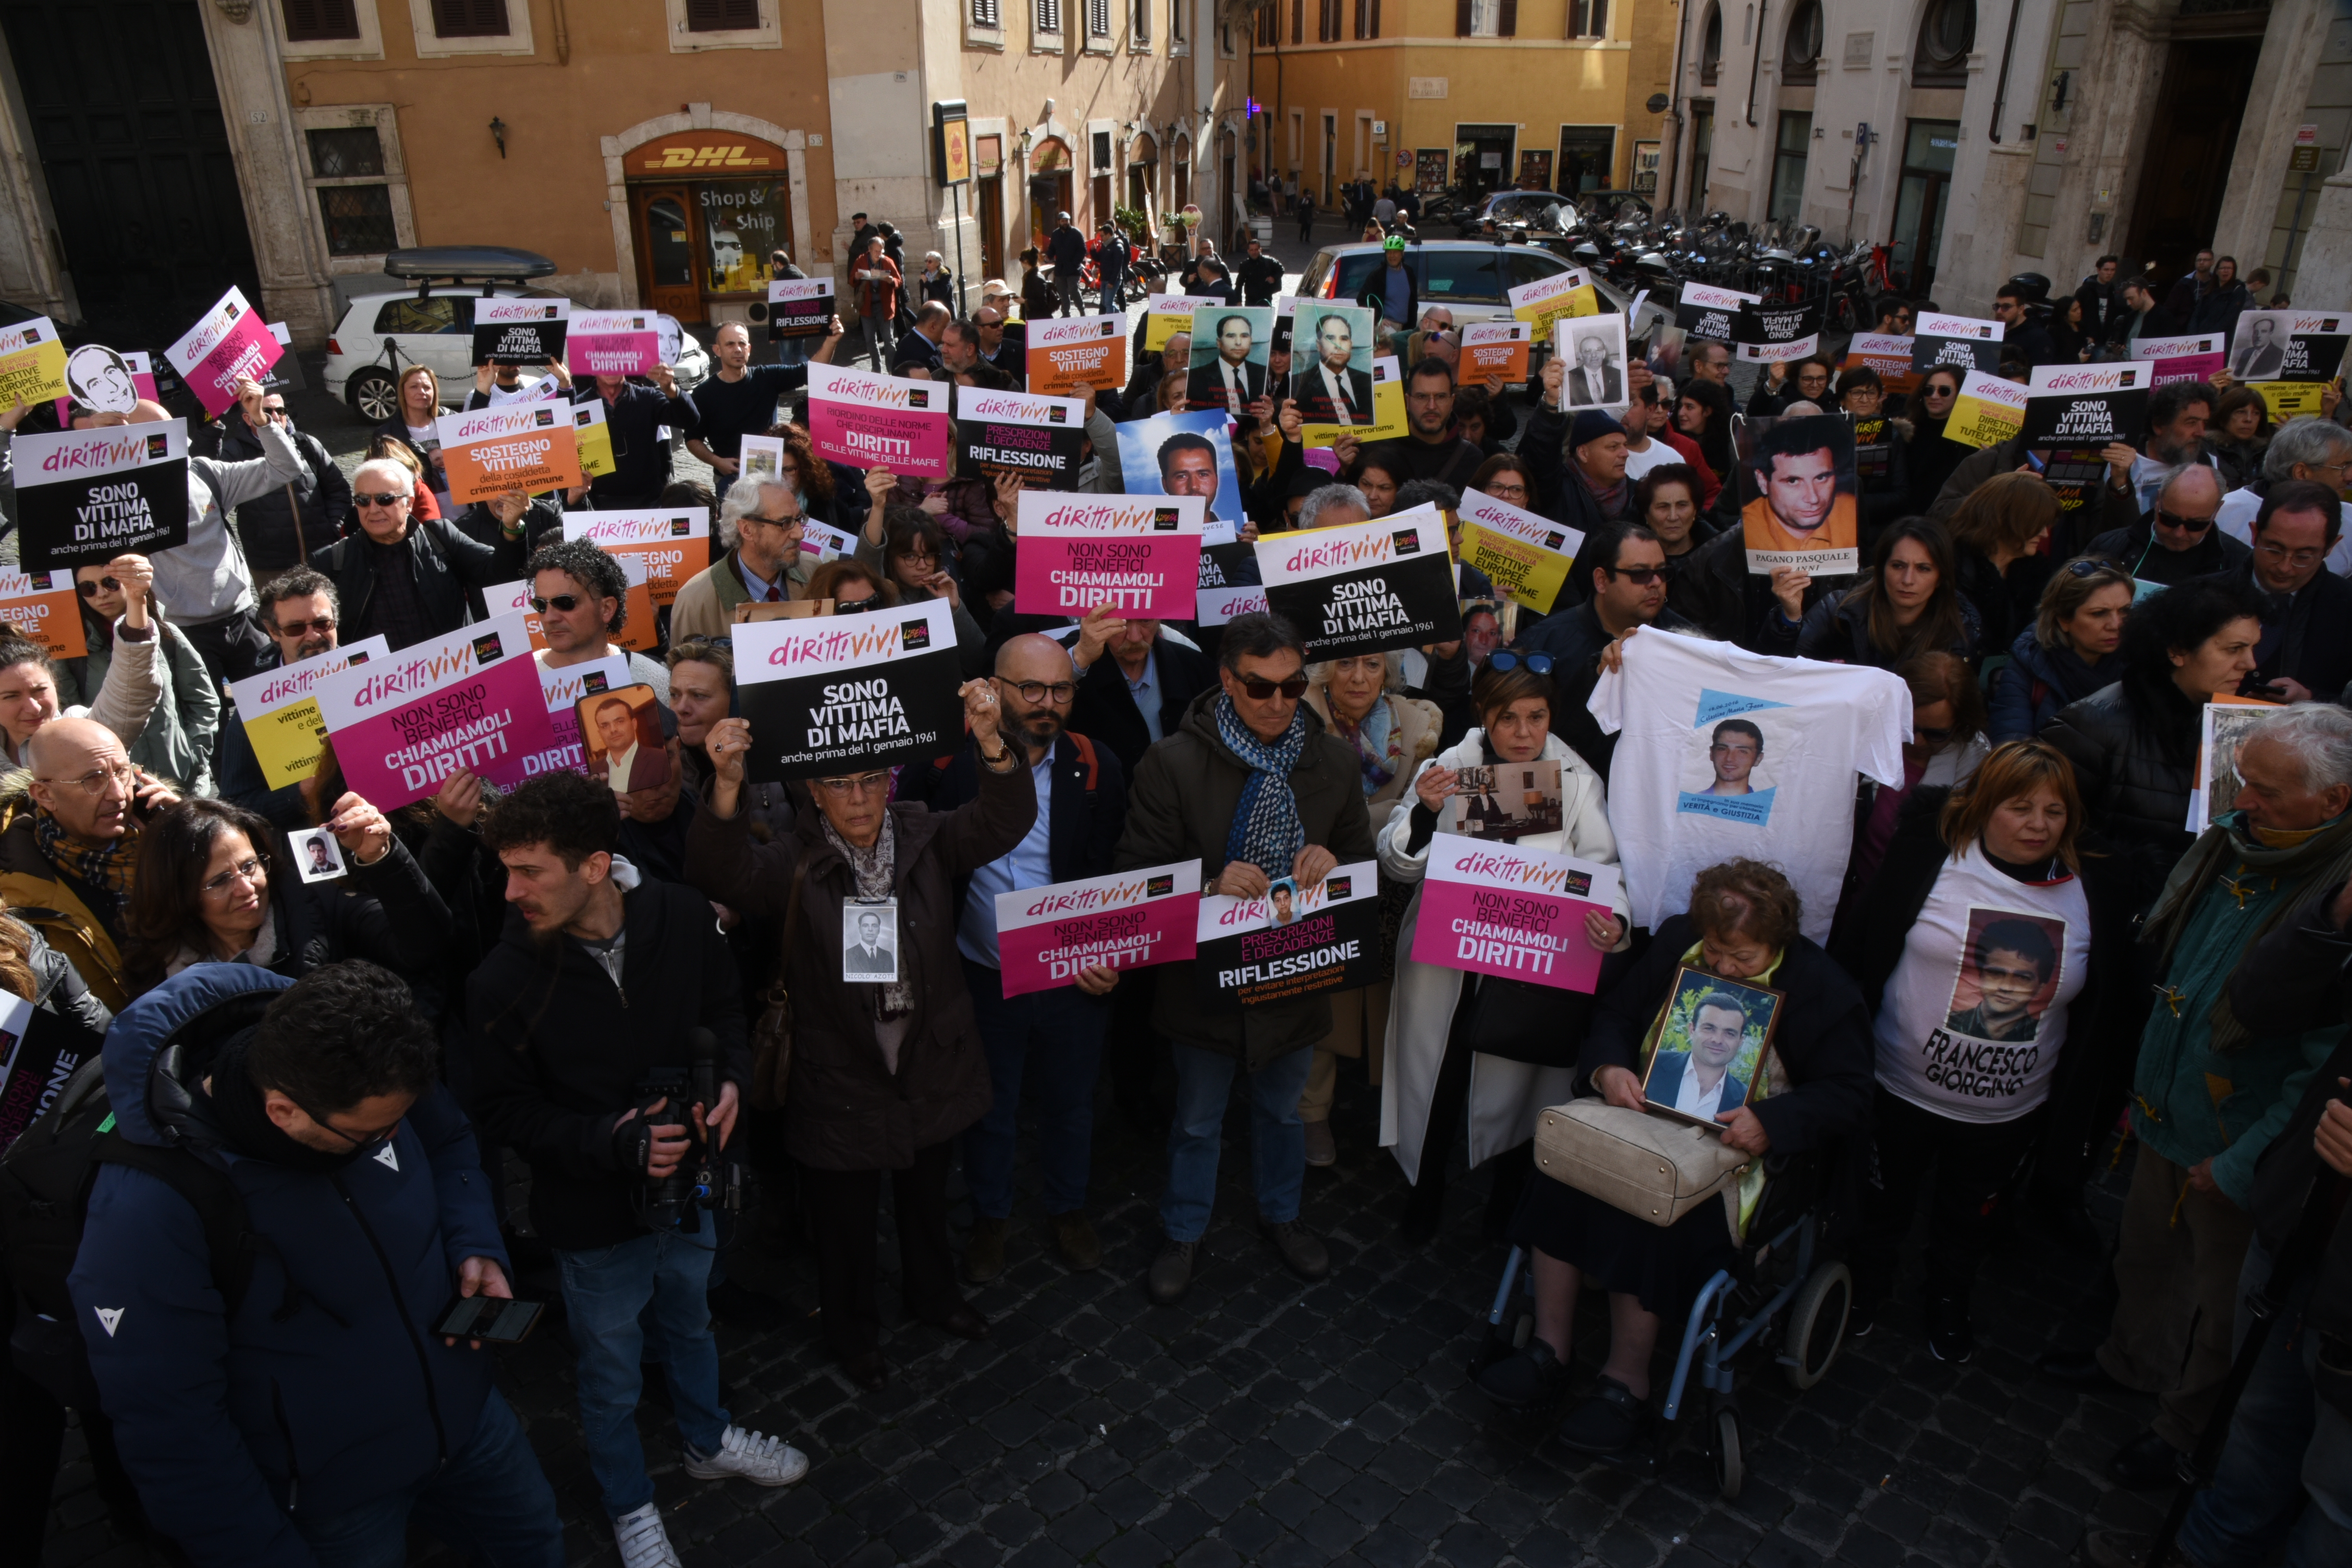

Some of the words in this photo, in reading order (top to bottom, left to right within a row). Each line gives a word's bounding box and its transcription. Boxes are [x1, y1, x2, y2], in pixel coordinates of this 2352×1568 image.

[253, 113, 266, 123] 52
[810, 136, 822, 145] 53
[1858, 125, 1865, 138] P
[662, 146, 752, 167] DHL
[701, 191, 745, 207] Shop
[750, 189, 764, 204] &
[508, 327, 536, 336] SONO
[776, 315, 828, 327] RIFLESSIONE
[1764, 323, 1799, 332] VITTIMA
[501, 336, 541, 345] VITTIMA
[1769, 330, 1794, 339] SONO
[207, 348, 225, 368] NON
[224, 330, 243, 353] SONO
[216, 341, 249, 373] BENEFICI
[497, 344, 507, 352] DI
[510, 344, 541, 353] MAFIA
[1049, 347, 1109, 362] SOSTEGNO
[1473, 348, 1514, 357] SOSTEGNO
[1939, 349, 1975, 361] VITTIMA
[1945, 341, 1970, 352] SONO
[6, 352, 41, 366] OPERATIVE
[16, 359, 39, 370] ITALIA
[214, 340, 261, 388] CHIAMIAMOLI
[1057, 358, 1101, 372] VITTIME
[1478, 356, 1507, 365] VITTIME
[1072, 370, 1105, 379] cosiddetta
[22, 379, 63, 397] VITTIME
[2061, 411, 2112, 423] VITTIMA
[2071, 400, 2106, 412] SONO
[827, 408, 867, 422] RIORDINO
[869, 415, 897, 427] DELLE
[899, 420, 932, 431] NORME
[837, 420, 853, 430] CHE
[855, 423, 916, 439] DISCIPLINANO
[1353, 425, 1394, 435] terrorismo
[2055, 423, 2069, 434] DI
[2072, 422, 2113, 434] MAFIA
[847, 431, 909, 455] DIRITTI
[986, 434, 991, 444] E
[994, 435, 1050, 450] DECADENZE
[987, 425, 1050, 440] PRESCRIZIONI
[1960, 426, 1992, 443] TUTELA
[471, 439, 550, 461] SOSTEGNO
[822, 441, 847, 454] DELLE
[848, 448, 879, 462] VITTIME
[881, 455, 909, 465] DELLE
[912, 458, 939, 467] MAFIE
[970, 446, 1065, 469] RIFLESSIONE
[483, 452, 543, 472] VITTIME
[470, 480, 523, 495] criminalità
[525, 475, 564, 487] comune
[480, 473, 501, 483] della
[505, 467, 550, 480] cosiddetta
[89, 482, 139, 505] SONO
[77, 497, 150, 523] VITTIMA
[75, 523, 95, 541] DI
[101, 513, 154, 538] MAFIA
[1068, 543, 1103, 557] NON
[1107, 544, 1151, 558] SONO
[1476, 529, 1509, 547] RENDERE
[1509, 544, 1546, 562] OPERATIVE
[1478, 538, 1505, 554] ANCHE
[1504, 549, 1513, 557] IN
[1513, 552, 1537, 566] ITALIA
[1073, 557, 1144, 572] BENEFICI
[1476, 546, 1532, 575] DIRETTIVE
[1756, 554, 1793, 563] PAGANO
[1795, 553, 1849, 563] PASQUALE
[1051, 570, 1163, 586] CHIAMIAMOLI
[1475, 557, 1525, 583] EUROPEE
[1060, 586, 1152, 609] DIRITTI
[1332, 578, 1386, 601] SONO
[1322, 593, 1403, 618] VITTIMA
[1324, 618, 1343, 635] DI
[1348, 608, 1410, 631] MAFIA
[1305, 636, 1330, 648] anche
[1332, 634, 1357, 646] prima
[1358, 631, 1372, 641] del
[1379, 627, 1413, 639] gennaio
[1415, 621, 1434, 632] 1961
[824, 679, 887, 704] SONO
[277, 705, 316, 724] vittime
[391, 709, 434, 732] NON
[436, 684, 486, 714] SONO
[810, 696, 904, 726] VITTIMA
[403, 702, 485, 745] BENEFICI
[808, 727, 831, 748] DI
[838, 715, 910, 743] MAFIA
[385, 708, 512, 769] CHIAMIAMOLI
[781, 752, 813, 763] anche
[815, 749, 846, 762] prima
[849, 743, 864, 755] del
[866, 742, 869, 752] 1
[874, 738, 913, 754] gennaio
[915, 731, 936, 743] 1961
[401, 730, 508, 791] DIRITTI
[1683, 802, 1710, 811] VERITÀ
[1721, 808, 1760, 820] GIUSTIZIA
[1473, 891, 1510, 911] NON
[1512, 899, 1559, 920] SONO
[1054, 920, 1093, 936] NON
[1098, 911, 1146, 929] SONO
[1476, 907, 1550, 933] BENEFICI
[1061, 924, 1138, 947] BENEFICI
[1241, 915, 1333, 949] PRESCRIZIONI
[1452, 918, 1568, 952] CHIAMIAMOLI
[1038, 931, 1161, 962] CHIAMIAMOLI
[1242, 949, 1252, 961] E
[1255, 927, 1336, 960] DECADENZE
[1457, 936, 1554, 974] DIRITTI
[1050, 946, 1149, 980] DIRITTI
[1219, 939, 1361, 988] RIFLESSIONE
[1238, 987, 1253, 996] per
[1255, 981, 1284, 991] evitare
[1286, 963, 1345, 986] interpretazioni
[1242, 986, 1302, 1005] ingiustamente
[1304, 975, 1343, 990] restrittive
[1922, 1028, 2038, 1075] FRANCESCO
